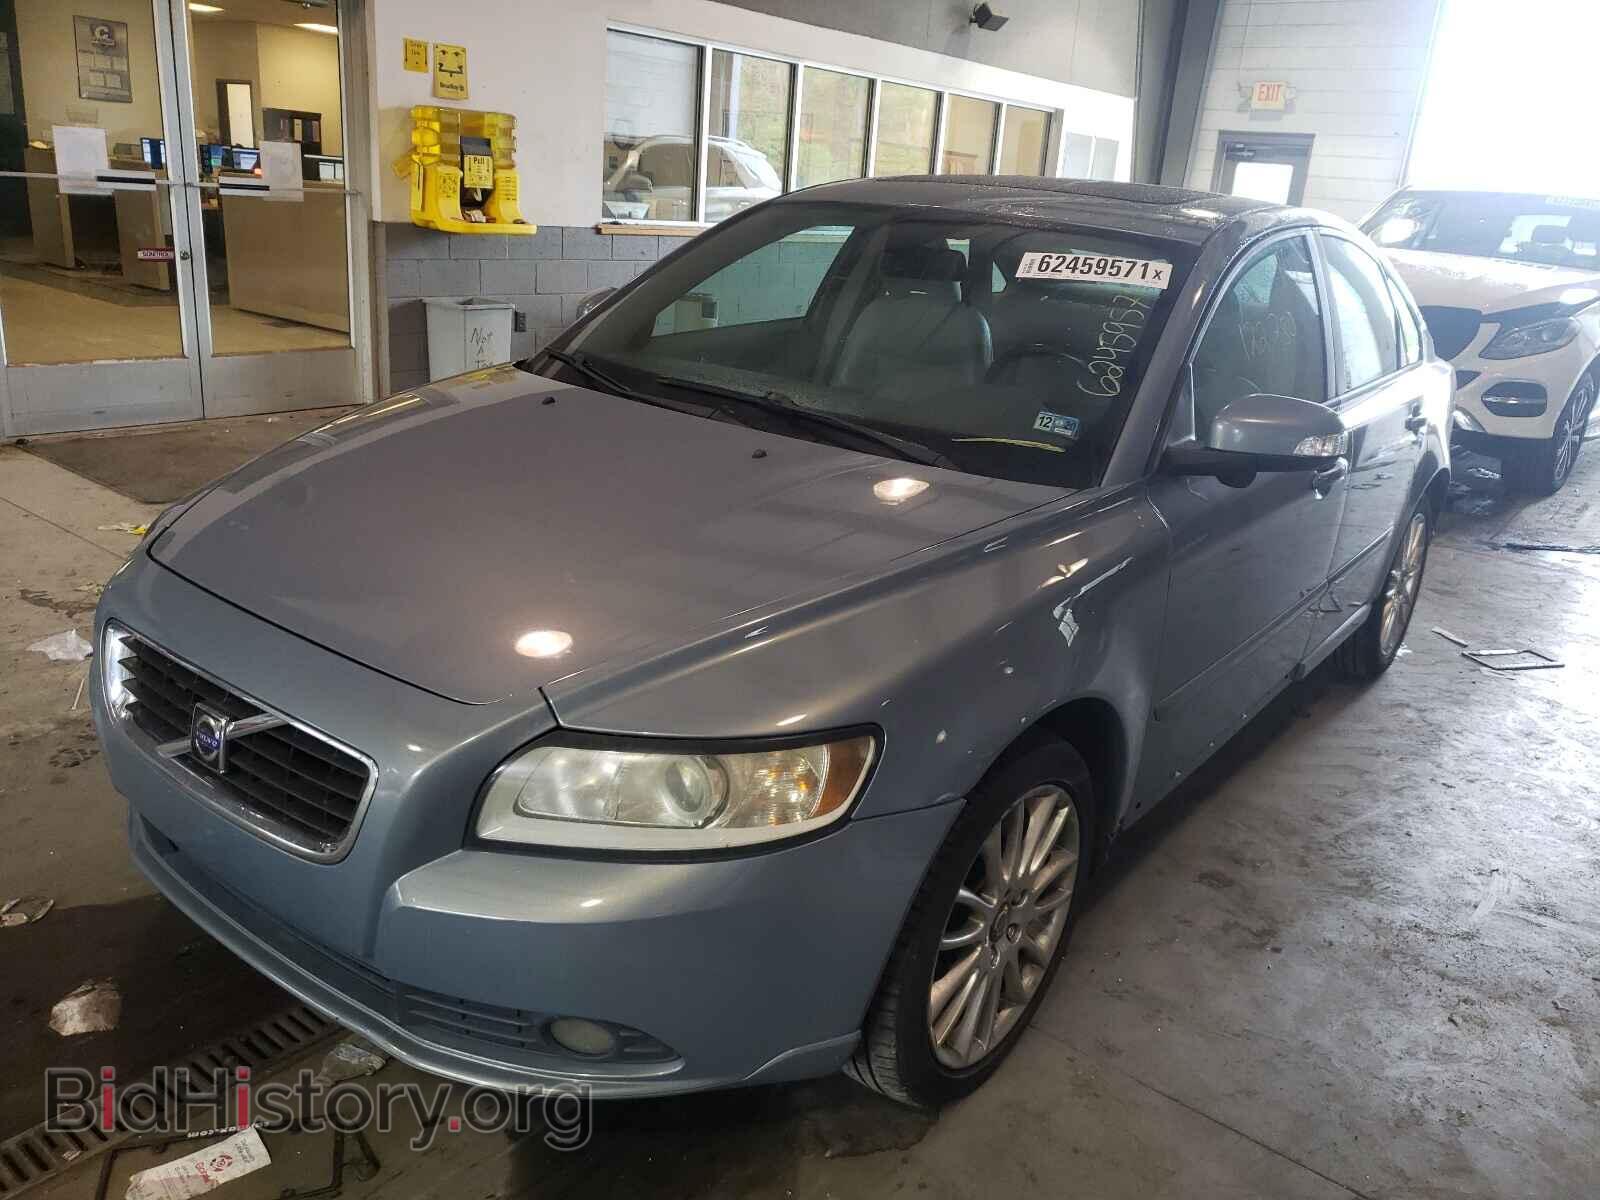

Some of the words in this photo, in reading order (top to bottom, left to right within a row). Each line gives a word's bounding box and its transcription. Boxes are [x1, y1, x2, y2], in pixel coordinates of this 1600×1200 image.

[1257, 83, 1281, 102] EXIT
[1037, 254, 1149, 280] 62459571
[1039, 415, 1053, 429] 12
